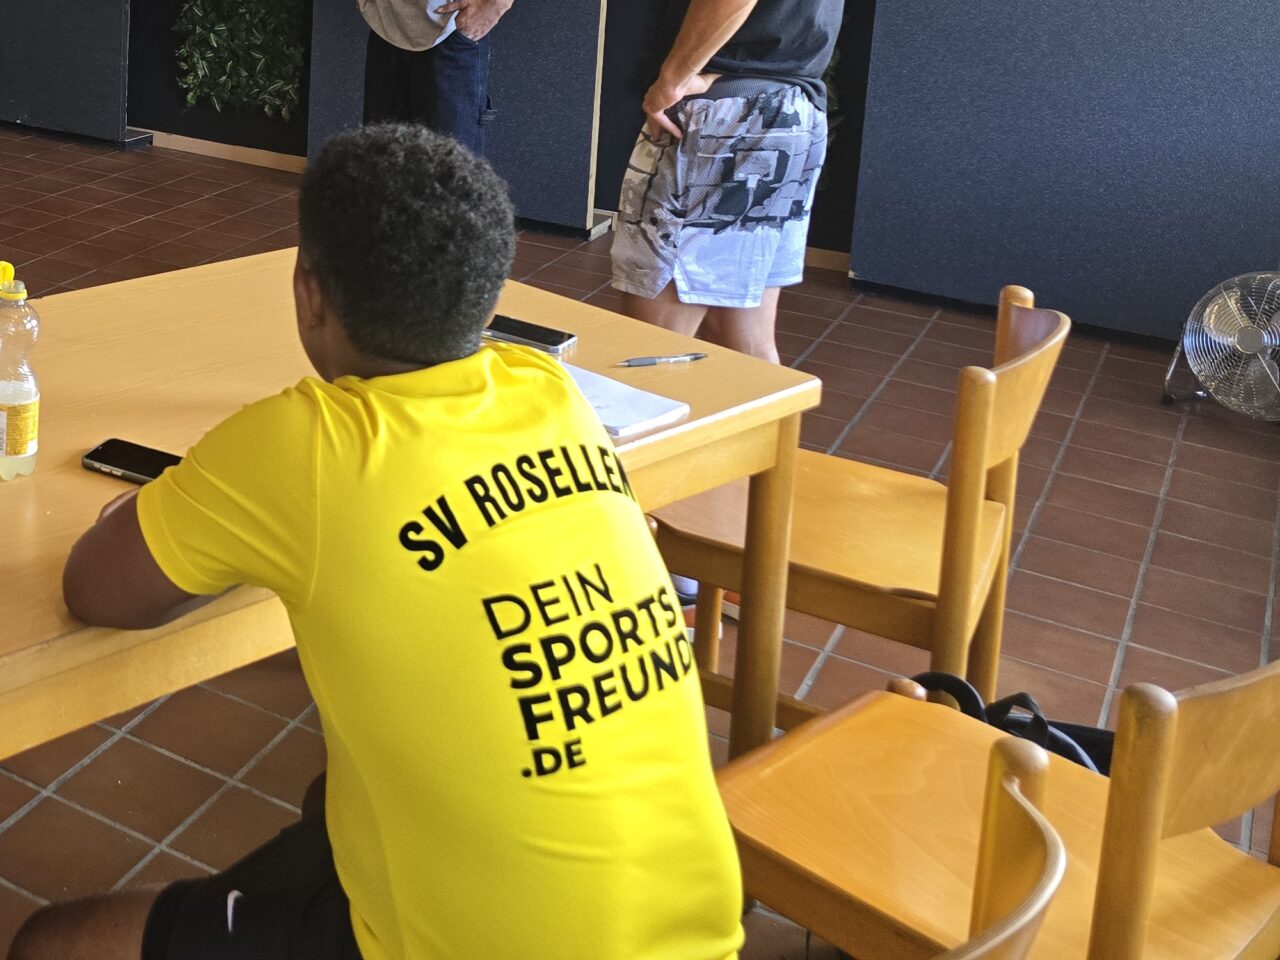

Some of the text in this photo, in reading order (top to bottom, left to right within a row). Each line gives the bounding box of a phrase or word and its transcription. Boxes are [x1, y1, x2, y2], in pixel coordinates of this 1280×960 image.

[398, 495, 469, 572] SV
[482, 563, 613, 640] DEIN
[501, 585, 677, 690] SPORTS
[517, 632, 692, 741] FREUND
[521, 738, 587, 778] .DE
